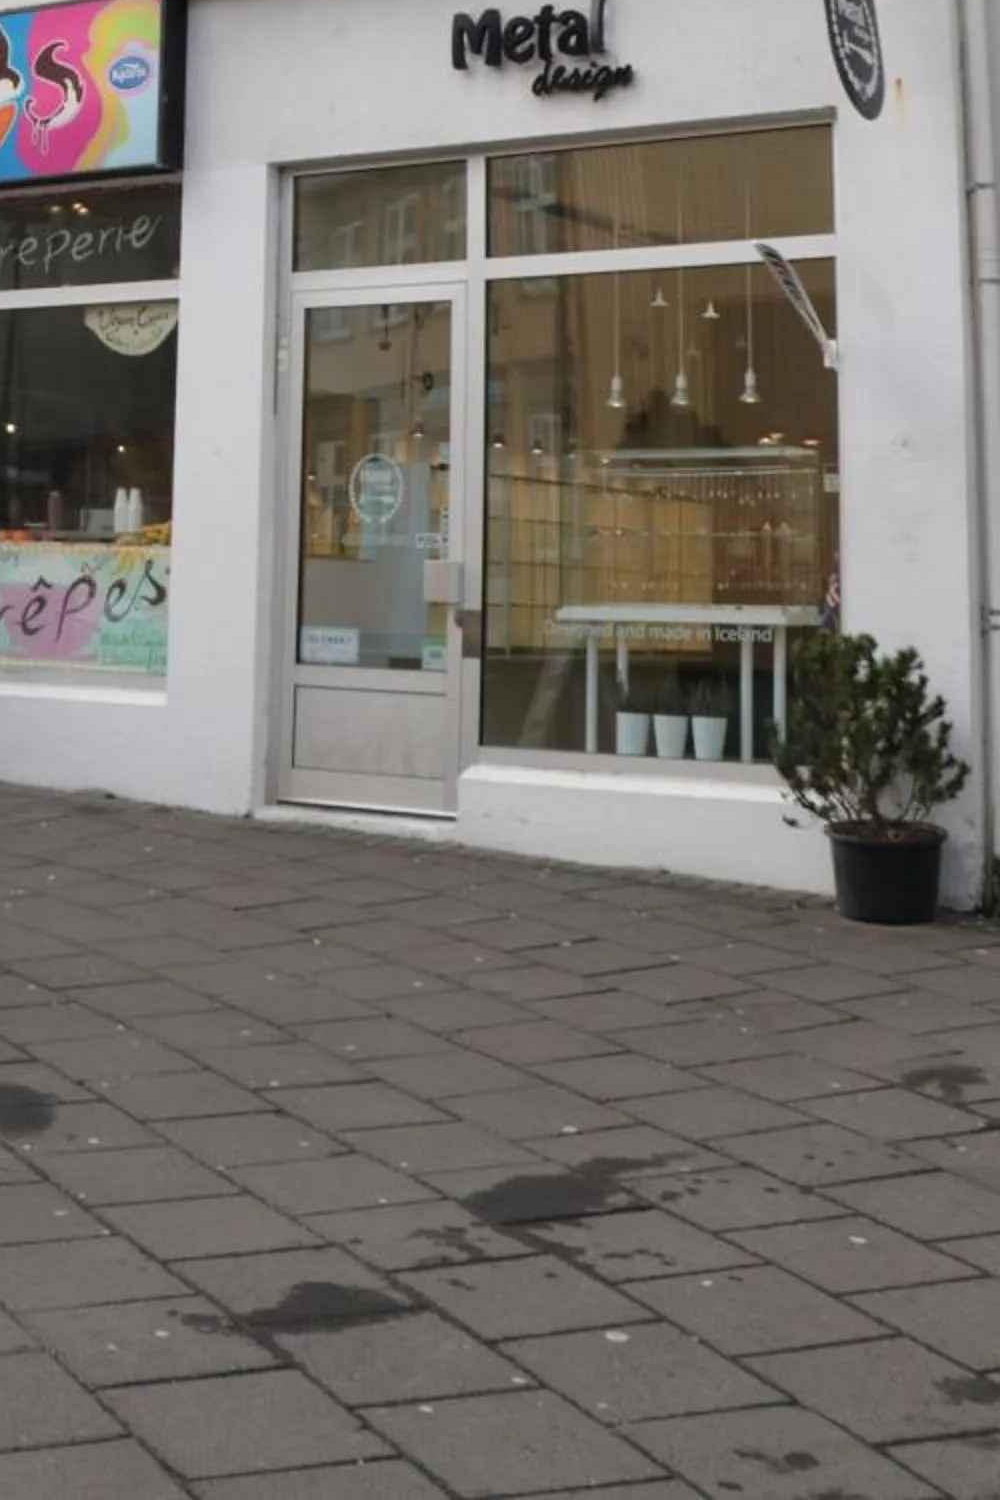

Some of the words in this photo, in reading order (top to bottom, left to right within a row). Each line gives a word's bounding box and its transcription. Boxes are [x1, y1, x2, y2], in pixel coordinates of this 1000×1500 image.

[531, 57, 634, 102] design
[616, 621, 646, 640] and
[650, 624, 692, 641] made
[696, 625, 712, 641] in
[715, 625, 773, 643] Iceland
